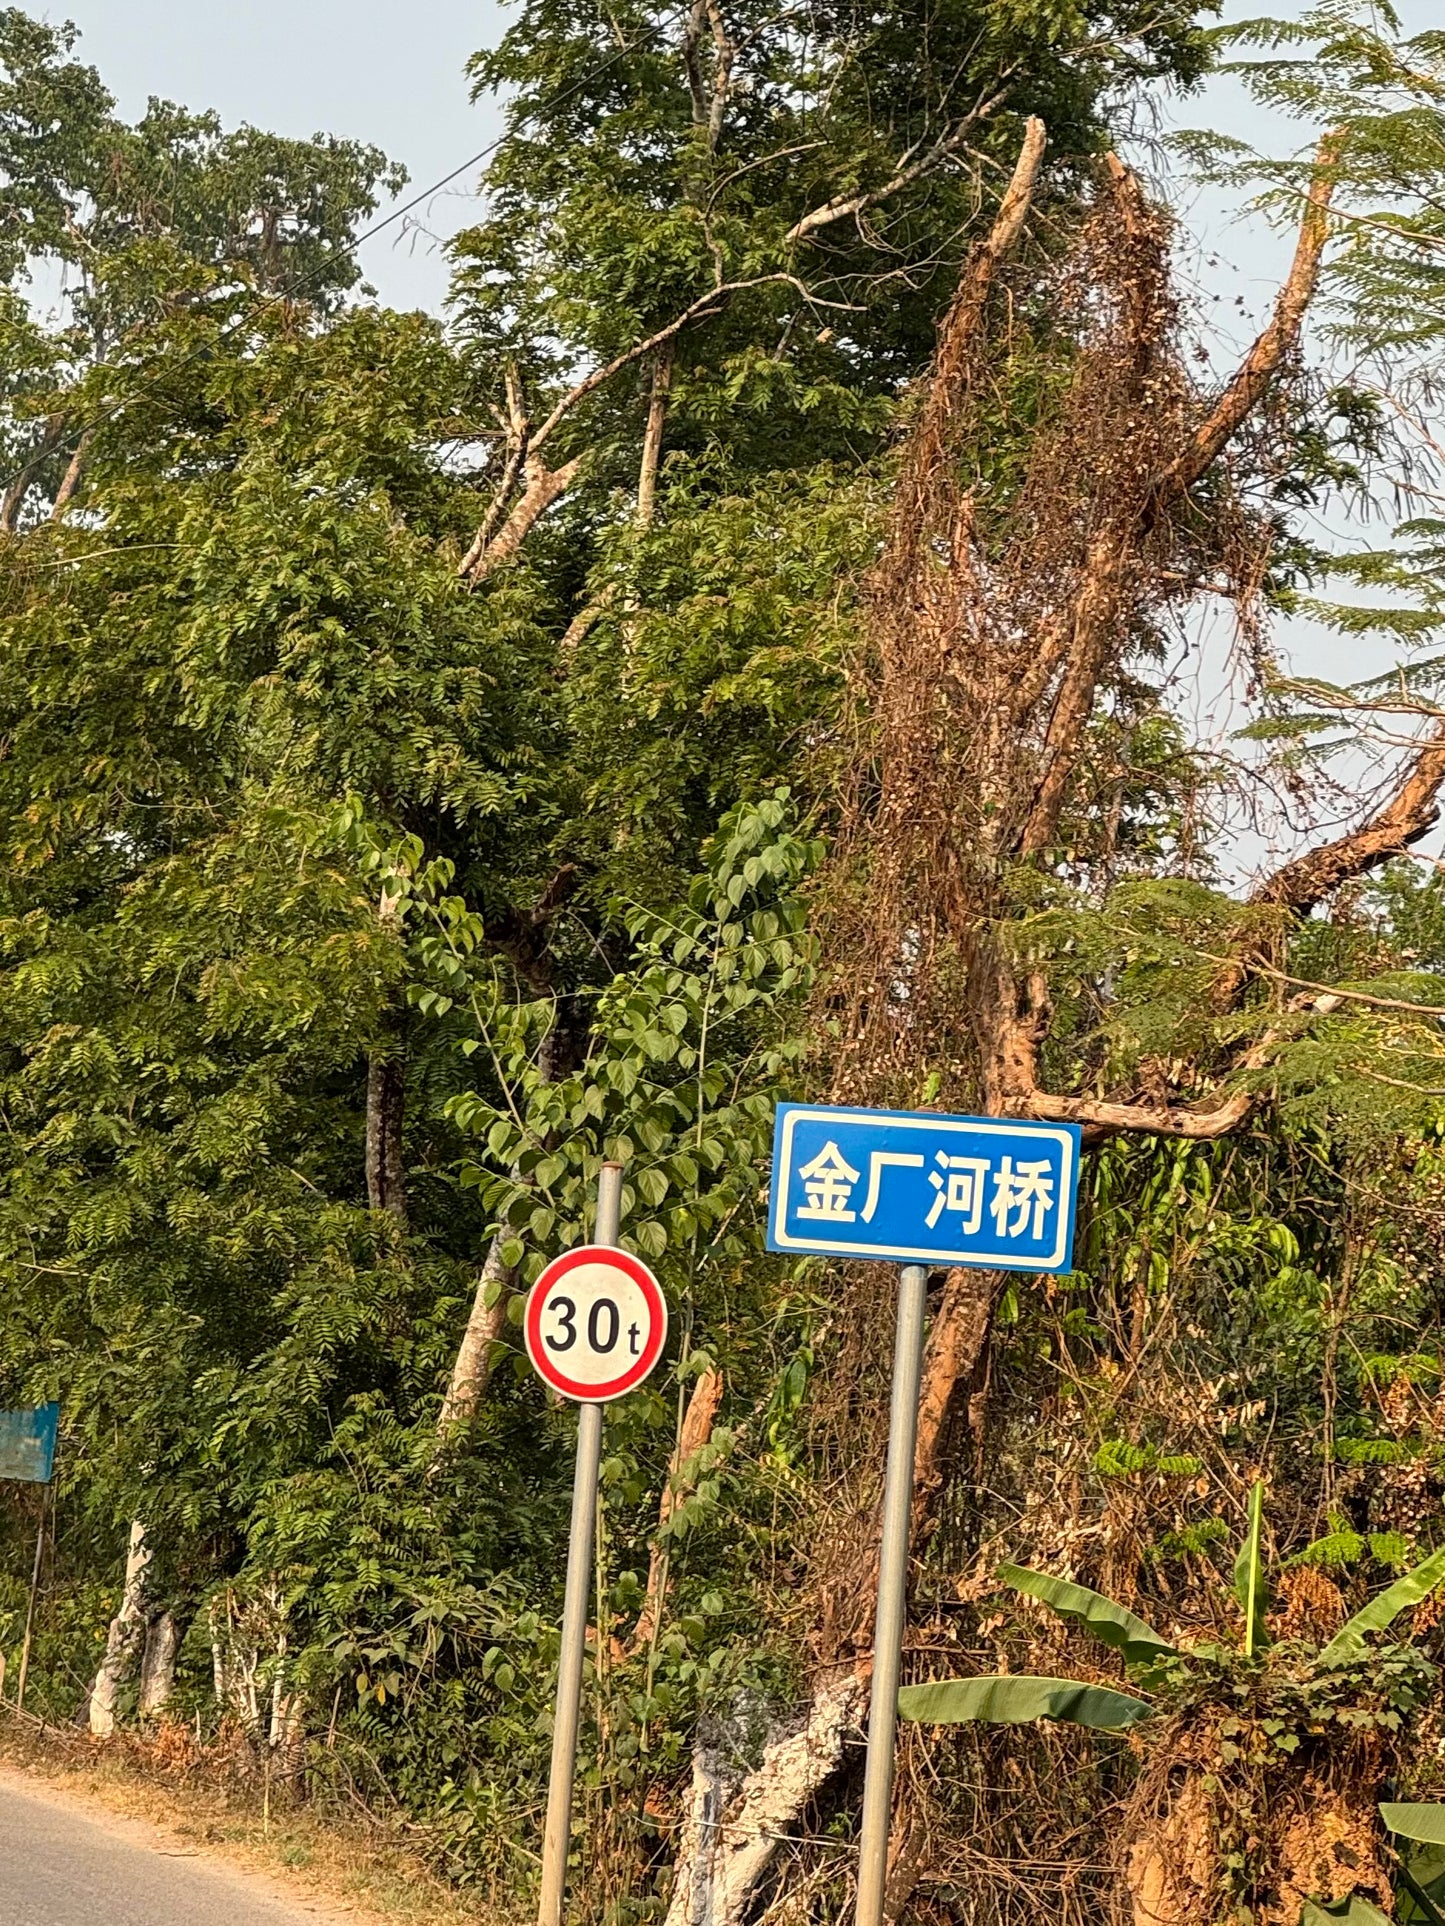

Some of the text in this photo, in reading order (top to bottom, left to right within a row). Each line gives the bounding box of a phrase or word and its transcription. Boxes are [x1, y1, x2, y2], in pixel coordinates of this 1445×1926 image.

[797, 1140, 1054, 1240] 金厂河桥
[545, 1296, 640, 1355] 30t
